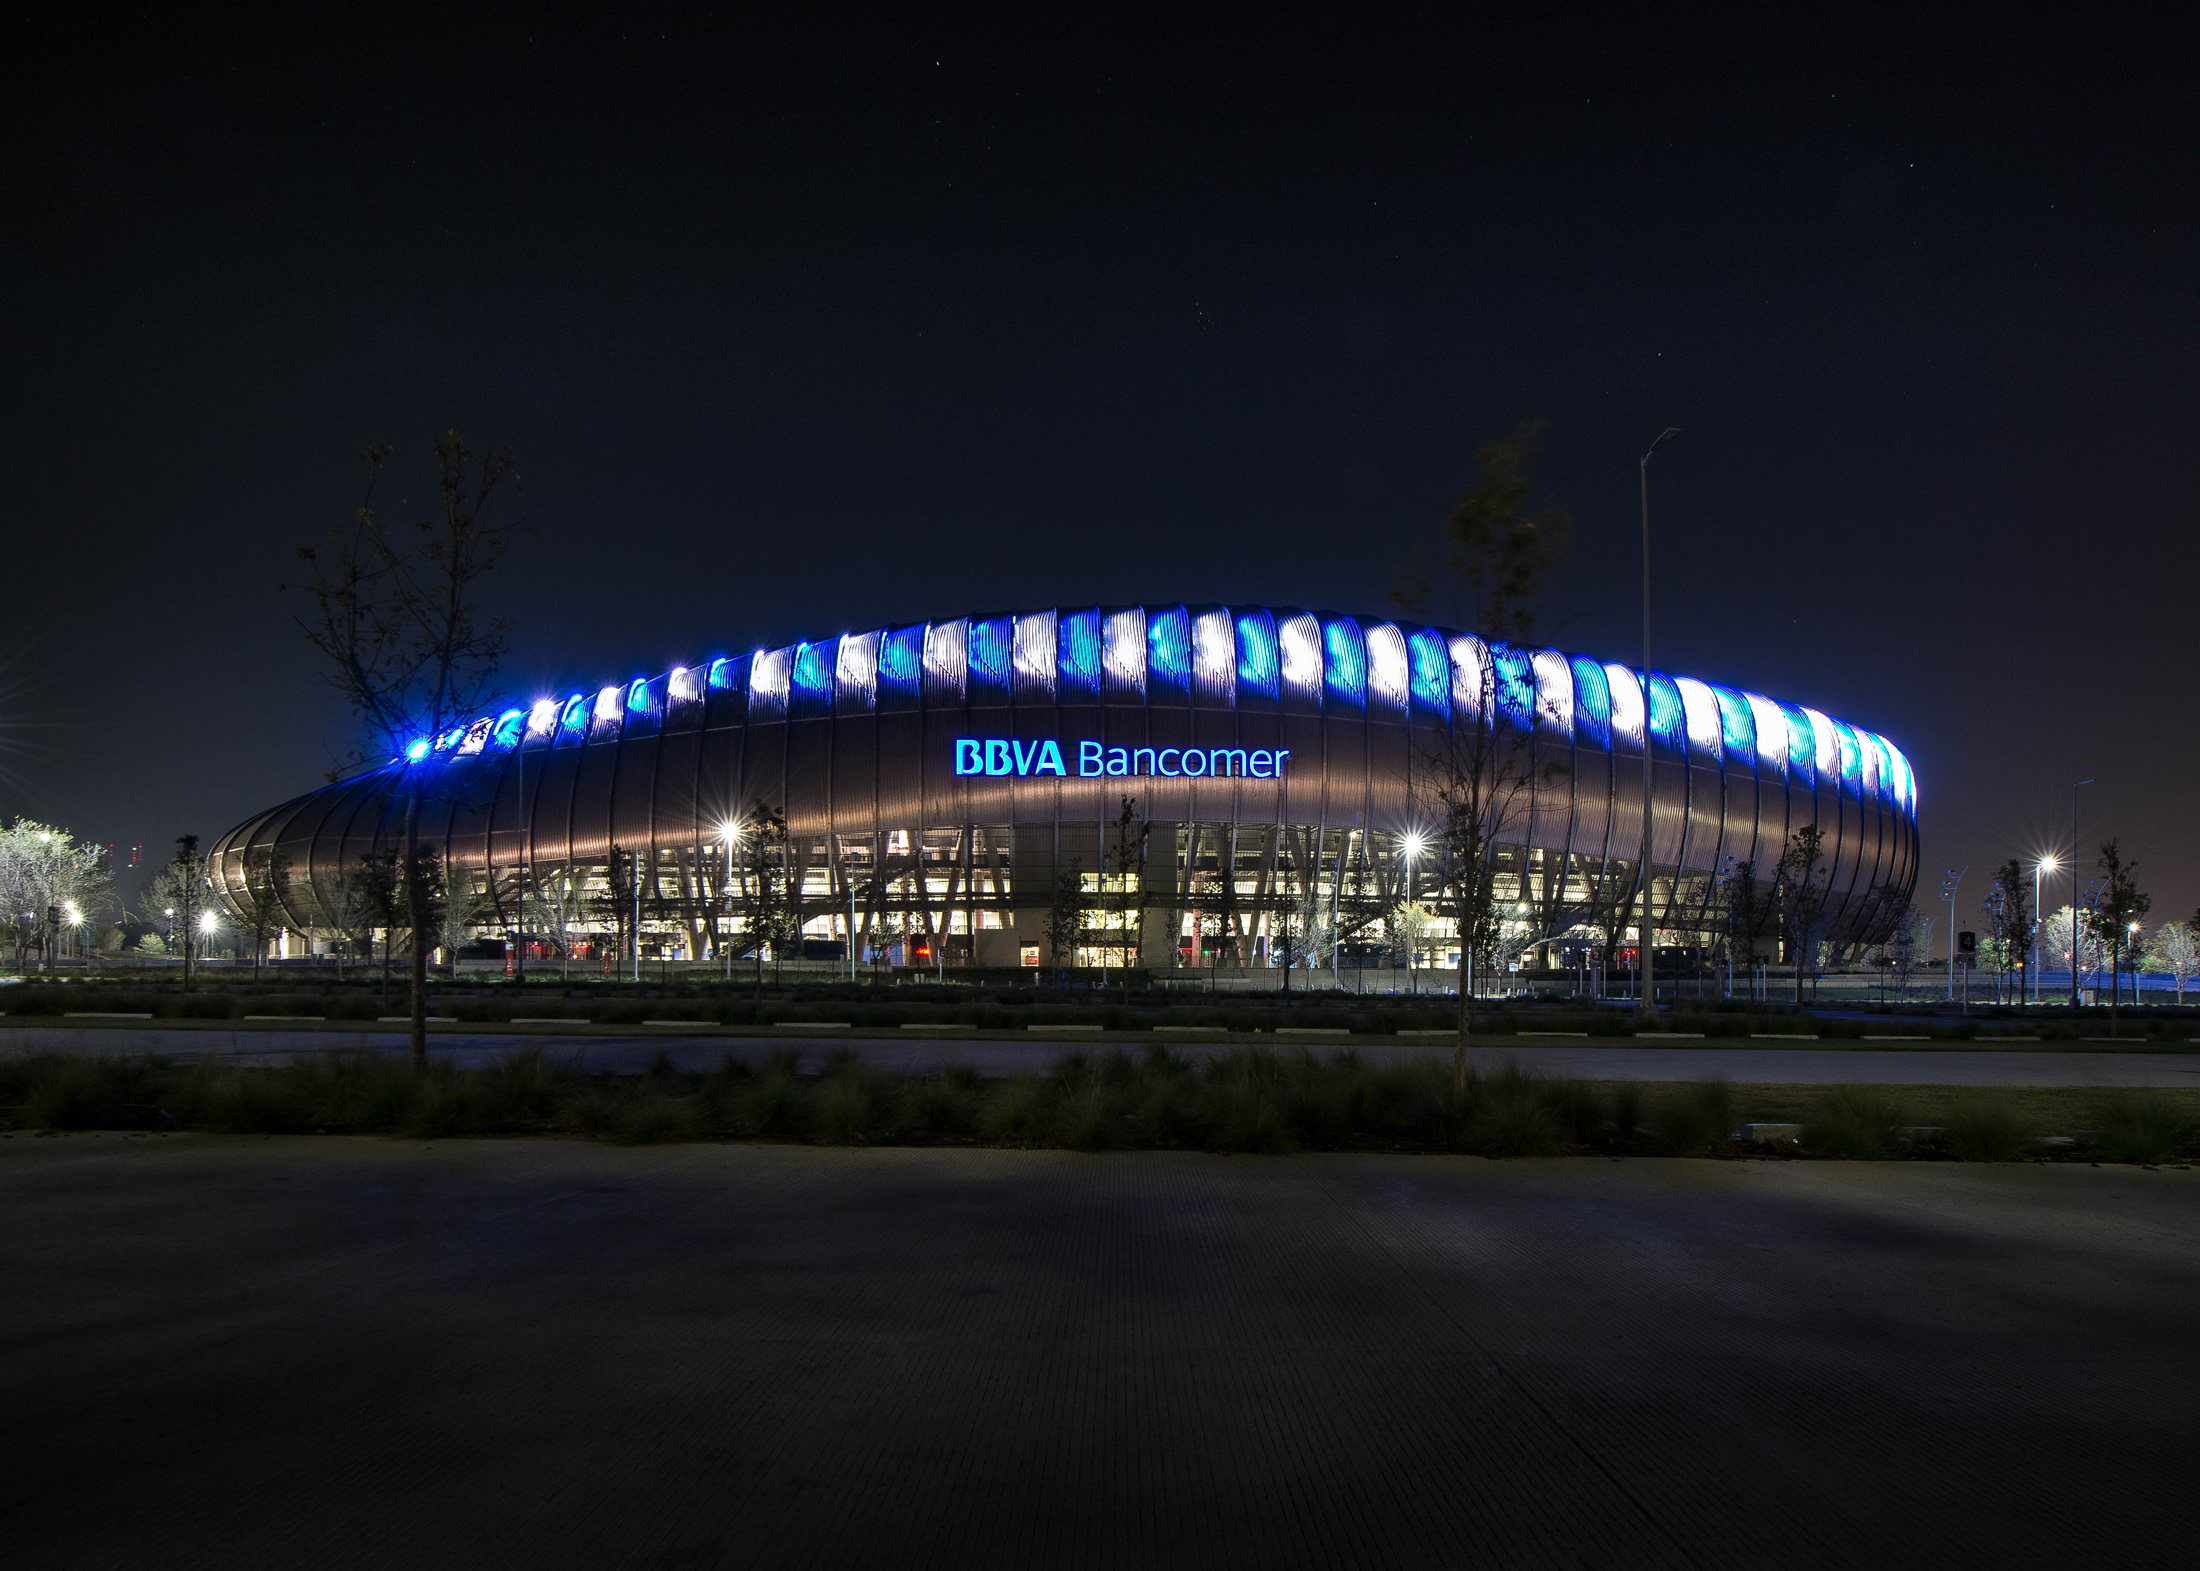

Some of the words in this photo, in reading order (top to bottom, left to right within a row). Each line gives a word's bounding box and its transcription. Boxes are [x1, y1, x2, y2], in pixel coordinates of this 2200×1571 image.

[955, 738, 1067, 777] BBVA
[1078, 740, 1290, 778] Bancomer
[1963, 936, 1972, 947] 4
